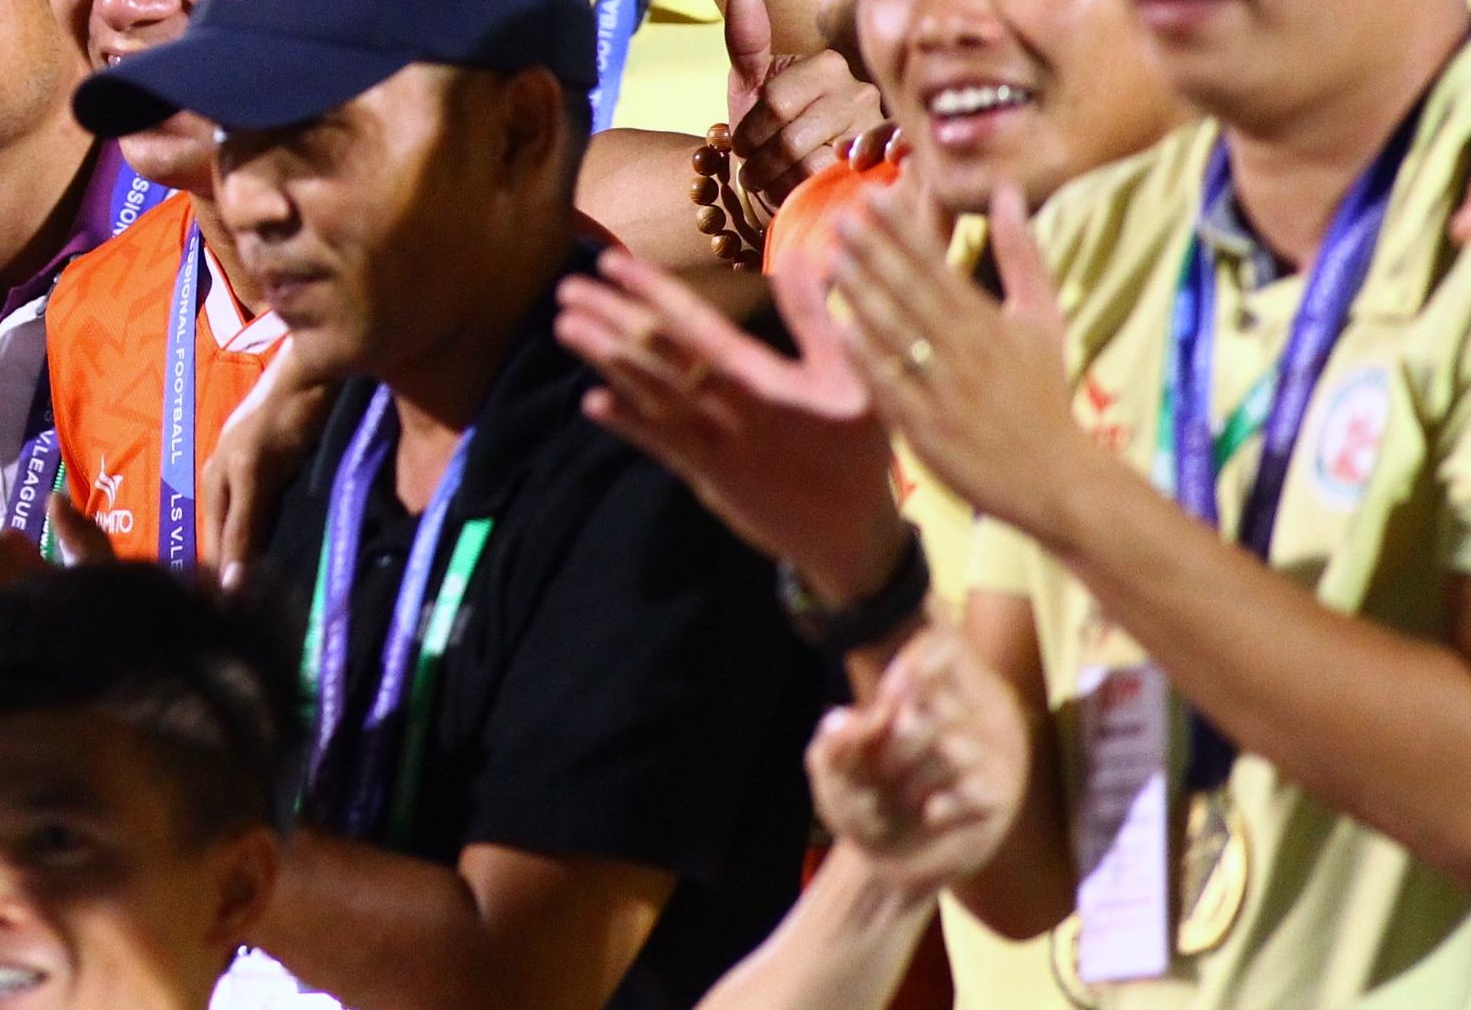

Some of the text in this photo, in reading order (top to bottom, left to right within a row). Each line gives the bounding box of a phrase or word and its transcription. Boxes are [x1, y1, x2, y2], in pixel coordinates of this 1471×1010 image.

[171, 348, 185, 465] FOOTBALL
[11, 429, 55, 531] V.LEAGUE
[92, 509, 134, 535] AMITO
[170, 493, 184, 573] LS V.LE
